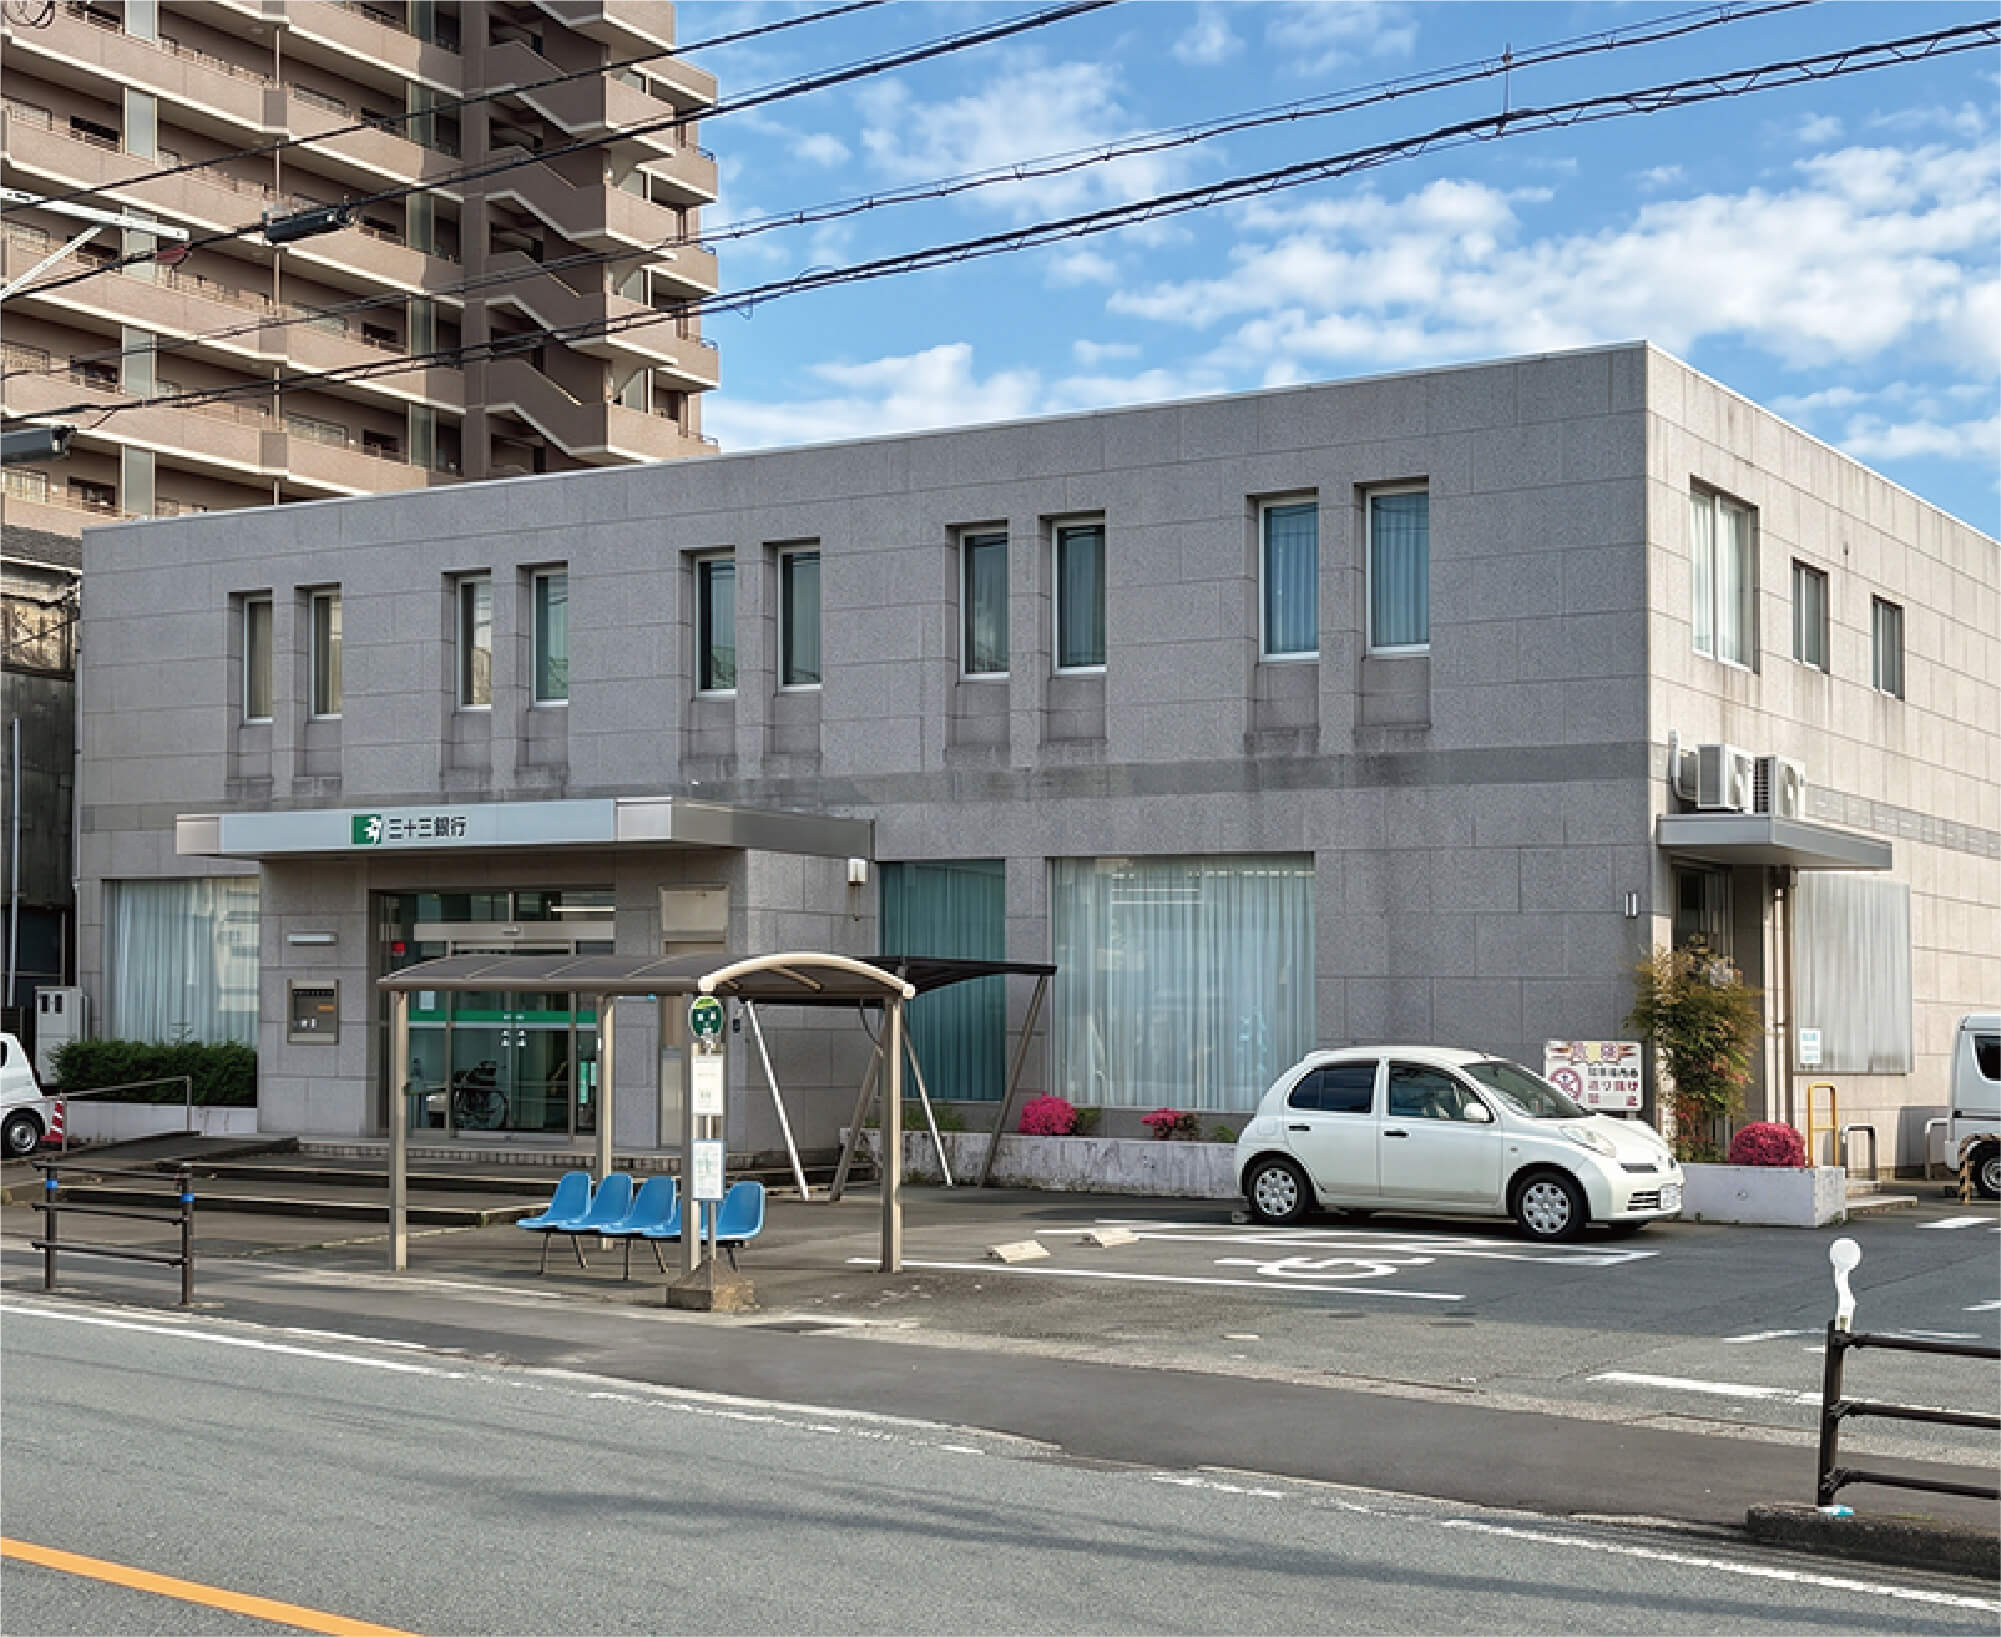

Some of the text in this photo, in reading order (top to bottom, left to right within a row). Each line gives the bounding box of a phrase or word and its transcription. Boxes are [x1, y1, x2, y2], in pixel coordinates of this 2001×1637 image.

[388, 816, 466, 840] 三十三銀行
